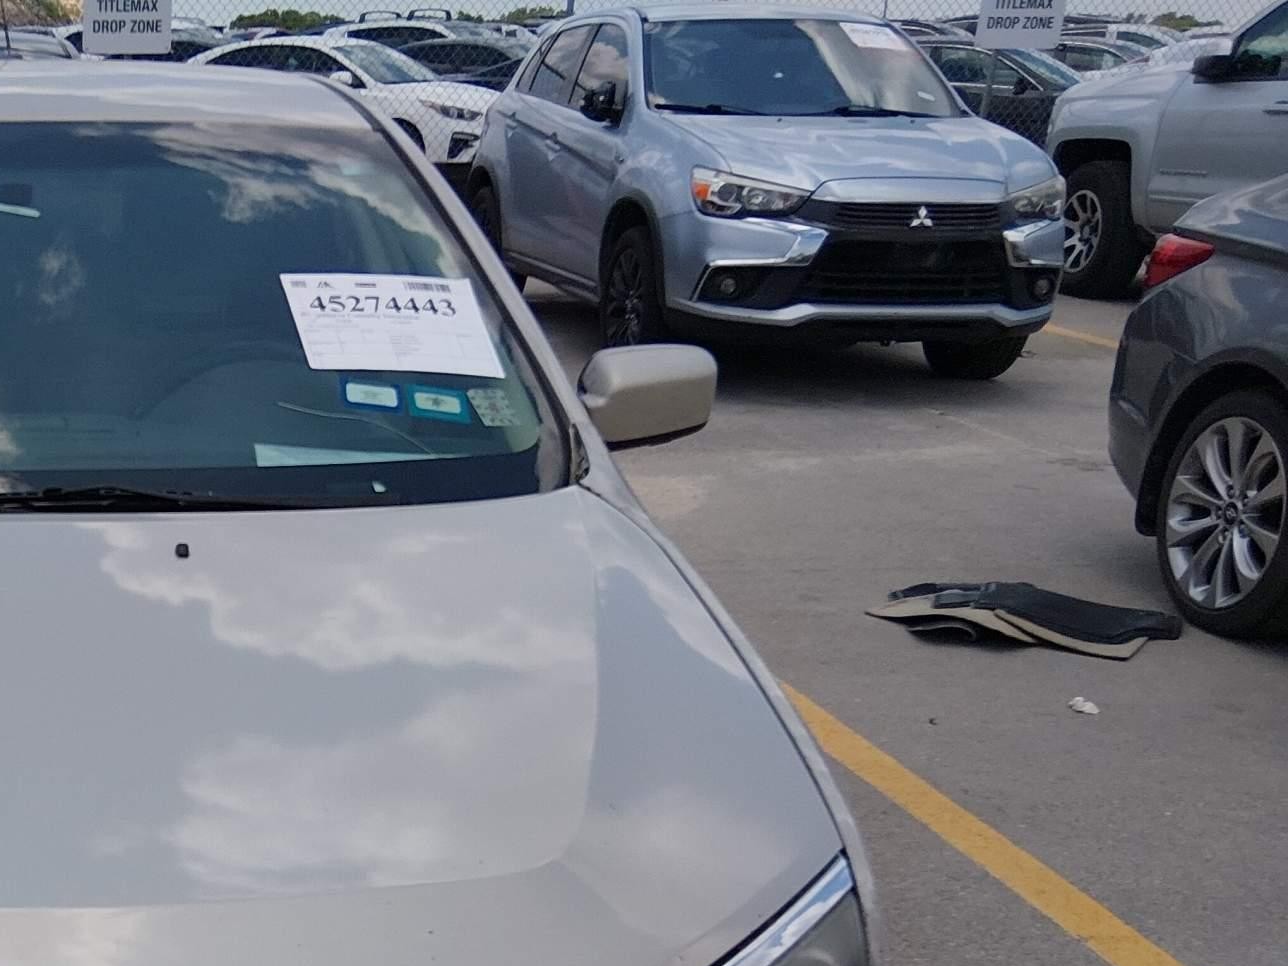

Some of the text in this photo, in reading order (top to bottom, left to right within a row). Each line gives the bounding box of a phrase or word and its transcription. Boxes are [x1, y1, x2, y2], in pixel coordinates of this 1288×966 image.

[97, 0, 158, 12] TITLEMAX
[92, 20, 162, 33] DROP ZONE
[987, 16, 1054, 29] DROP ZONE
[309, 295, 457, 317] 45274443
